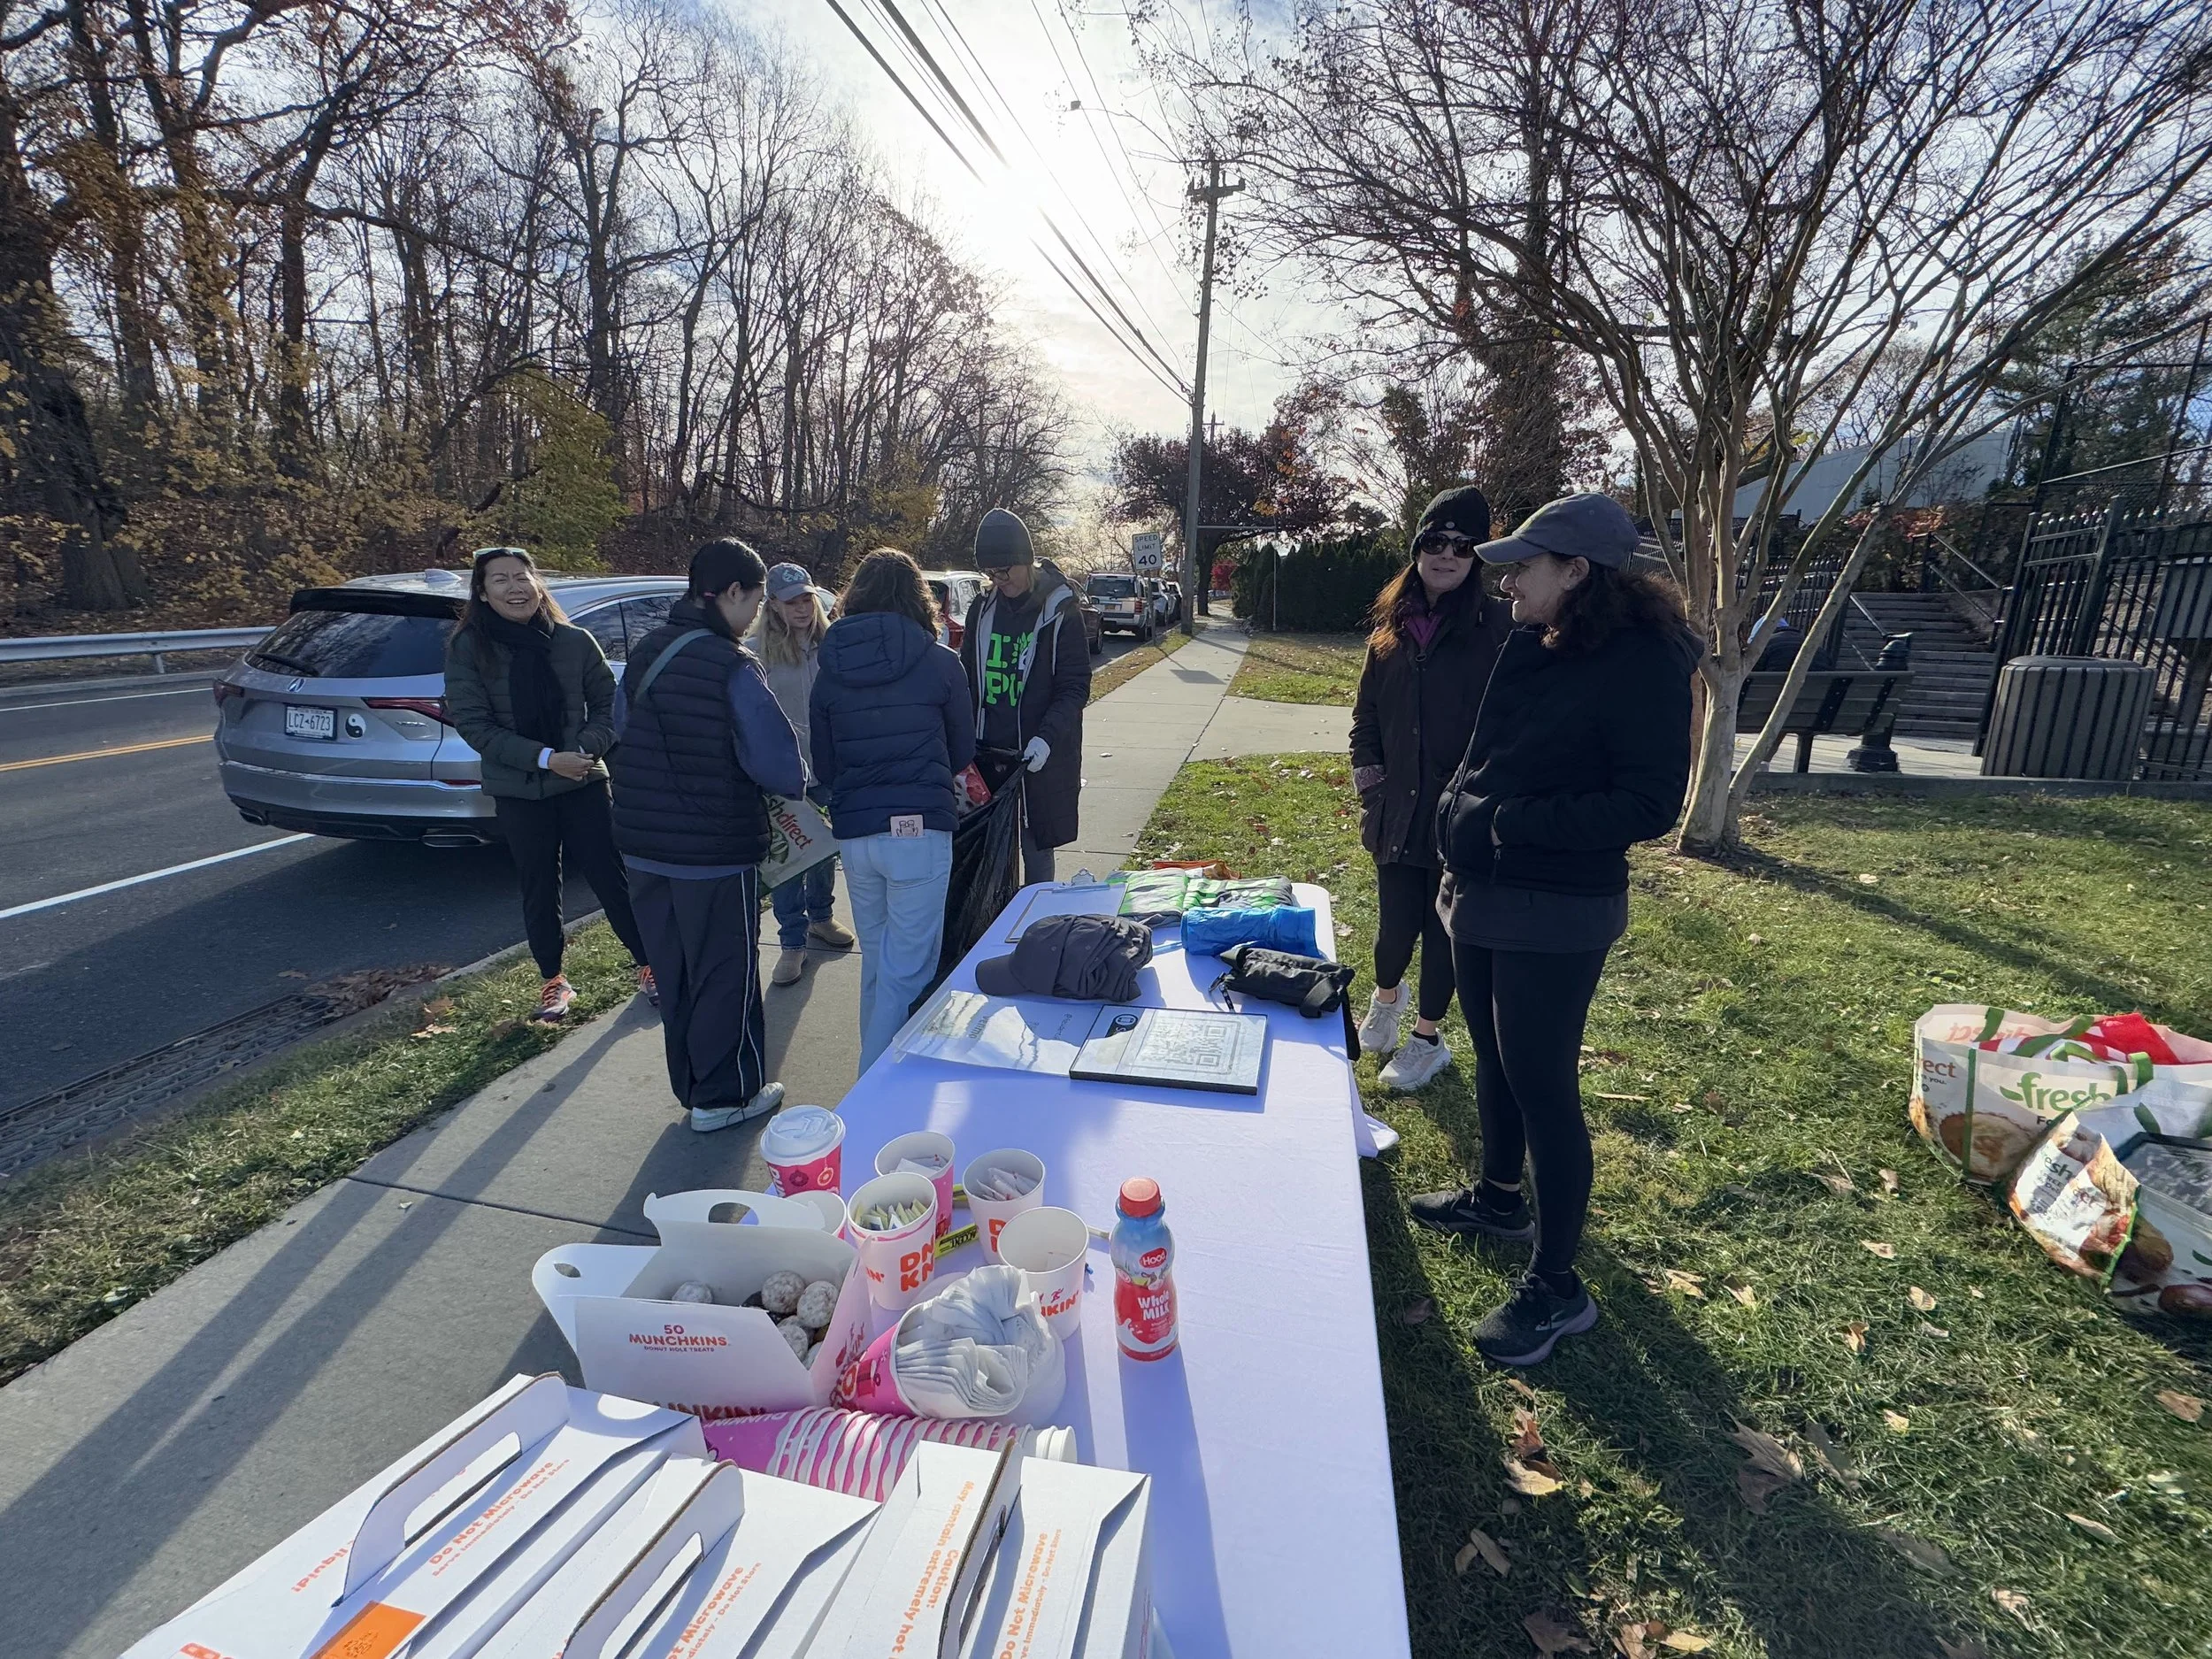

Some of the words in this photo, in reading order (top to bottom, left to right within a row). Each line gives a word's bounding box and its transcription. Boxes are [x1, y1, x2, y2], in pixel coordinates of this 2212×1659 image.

[1138, 554, 1157, 565] 40
[1141, 1248, 1167, 1266] Hood
[1138, 1290, 1170, 1310] Whole
[1143, 1302, 1170, 1321] MILK
[628, 1333, 728, 1347] MUNCHKINS
[664, 1324, 685, 1334] 50
[956, 1479, 975, 1502] May
[429, 1547, 454, 1564] Do
[452, 1520, 484, 1545] Not
[481, 1462, 554, 1519] Microwave
[936, 1503, 963, 1548] contain
[903, 1548, 942, 1622] extremely
[926, 1548, 960, 1609] Caution:
[1006, 1607, 1026, 1637] Not
[1017, 1532, 1048, 1604] Microwave
[680, 1566, 744, 1644] Microwave
[687, 1623, 716, 1659] diately
[717, 1603, 731, 1616] Do
[727, 1585, 744, 1602] Not
[741, 1563, 762, 1586] Store
[1022, 1585, 1048, 1644] Immediately
[891, 1623, 914, 1654] hot
